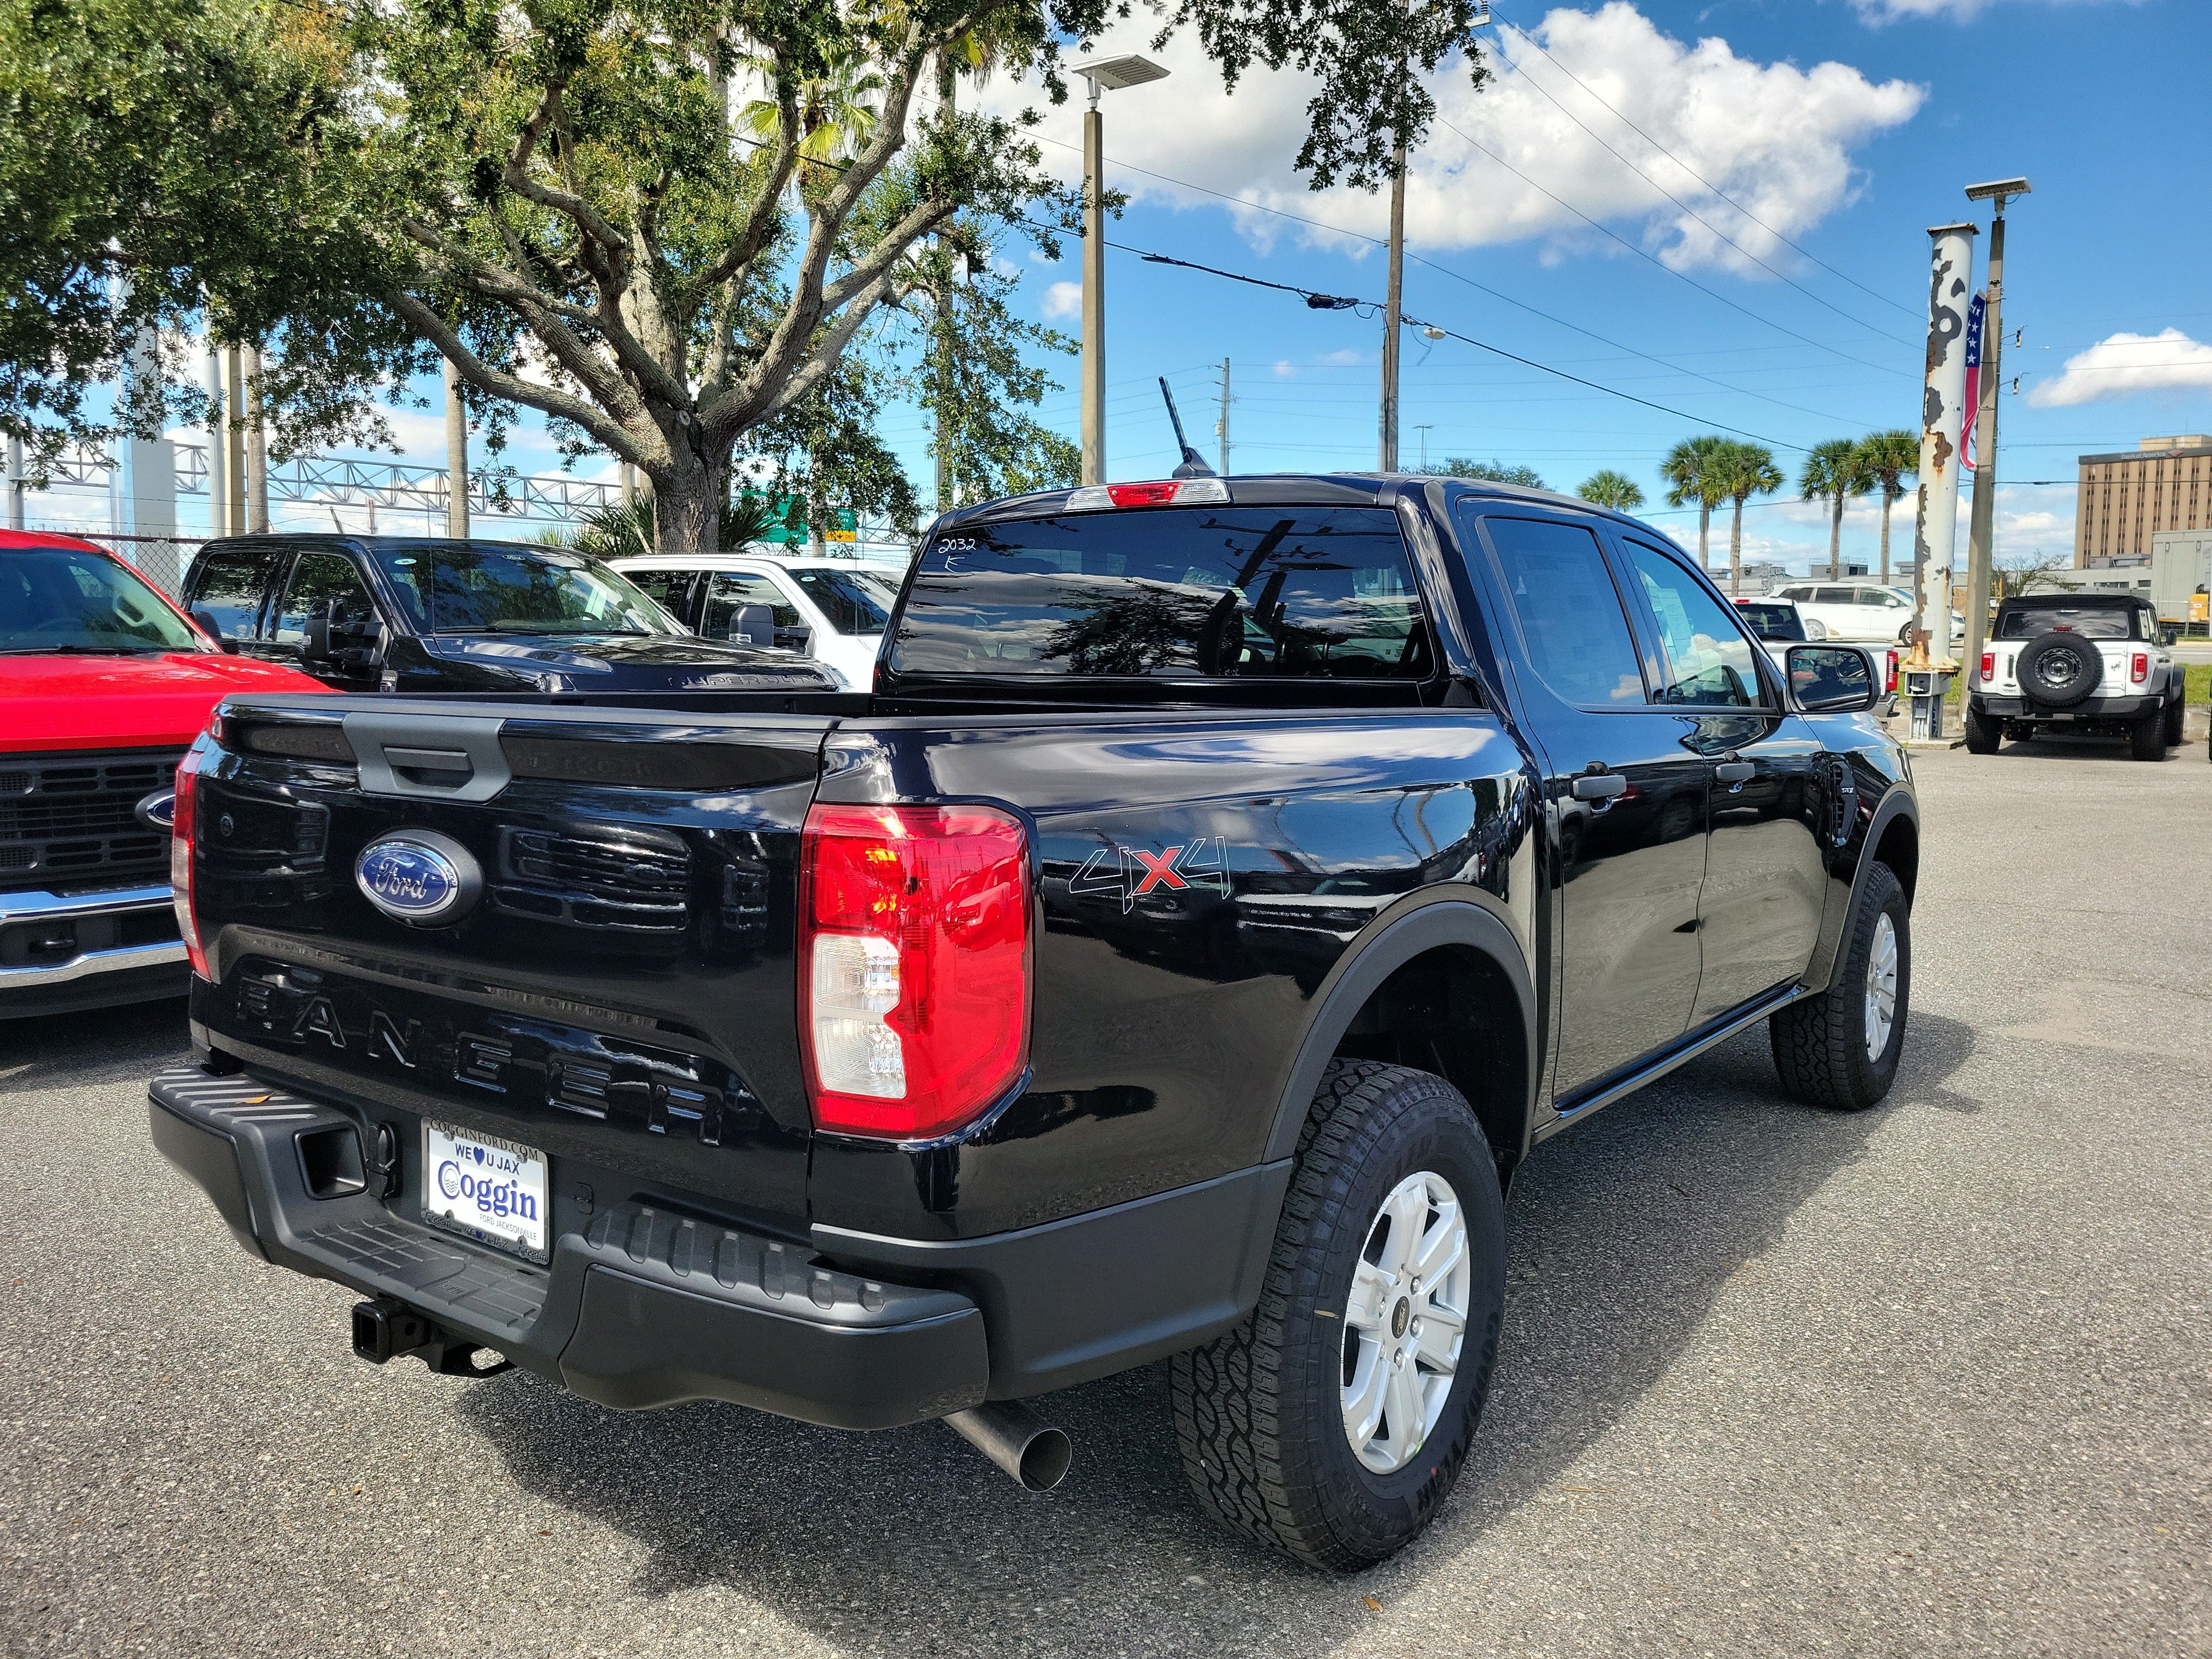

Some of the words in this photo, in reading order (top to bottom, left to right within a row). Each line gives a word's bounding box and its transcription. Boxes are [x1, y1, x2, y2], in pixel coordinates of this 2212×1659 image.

[938, 539, 977, 554] 2032
[375, 856, 427, 900] Ford
[236, 977, 724, 1147] RANGER
[430, 1118, 538, 1161] COGGINFORD.COM
[497, 1157, 520, 1176] JAX
[438, 1160, 538, 1222] Coggin
[479, 1214, 495, 1225] FORD
[496, 1220, 537, 1241] JACKSONVILLE
